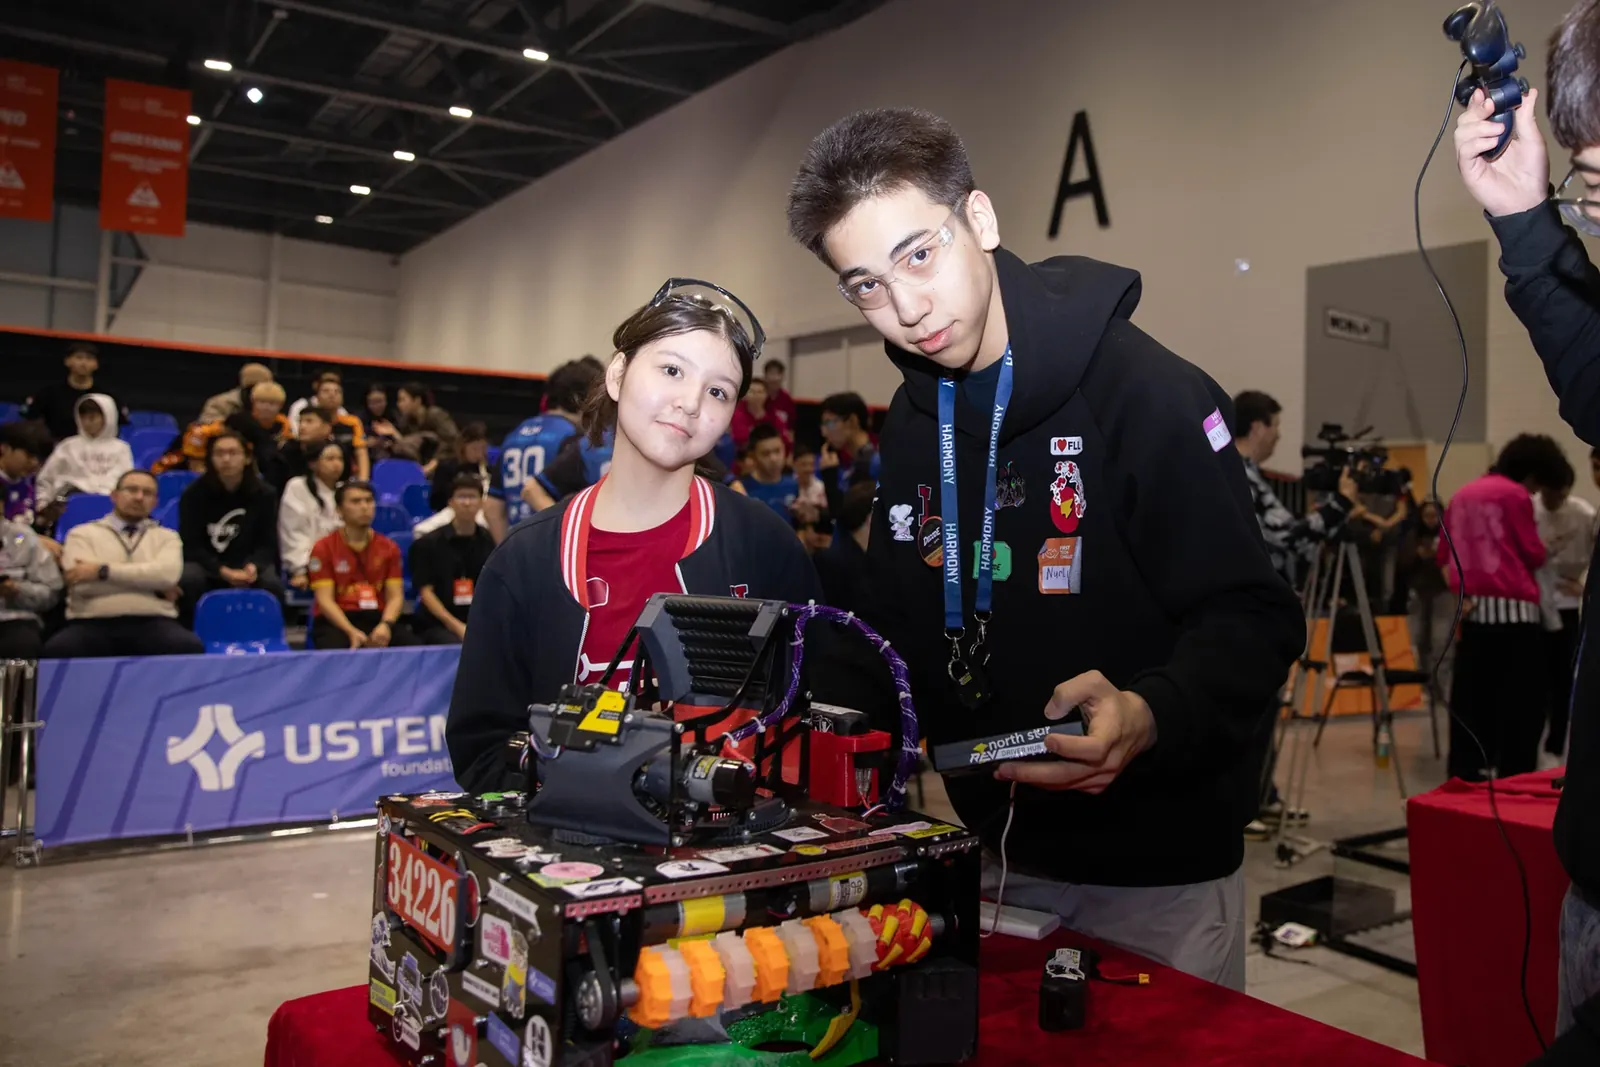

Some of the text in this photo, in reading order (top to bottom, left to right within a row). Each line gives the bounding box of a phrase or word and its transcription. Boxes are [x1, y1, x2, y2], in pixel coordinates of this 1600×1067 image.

[1047, 109, 1110, 240] A
[942, 424, 955, 485] HARMONY
[989, 404, 1004, 467] HARMONY
[1068, 441, 1081, 450] FLL
[503, 445, 545, 488] 30
[945, 523, 959, 584] HARMONY
[980, 507, 993, 571] HARMONY
[381, 758, 453, 777] foundat
[970, 750, 1000, 763] REV
[1001, 746, 1026, 757] DRIVER
[989, 726, 1051, 750] north star
[388, 842, 456, 945] 34226
